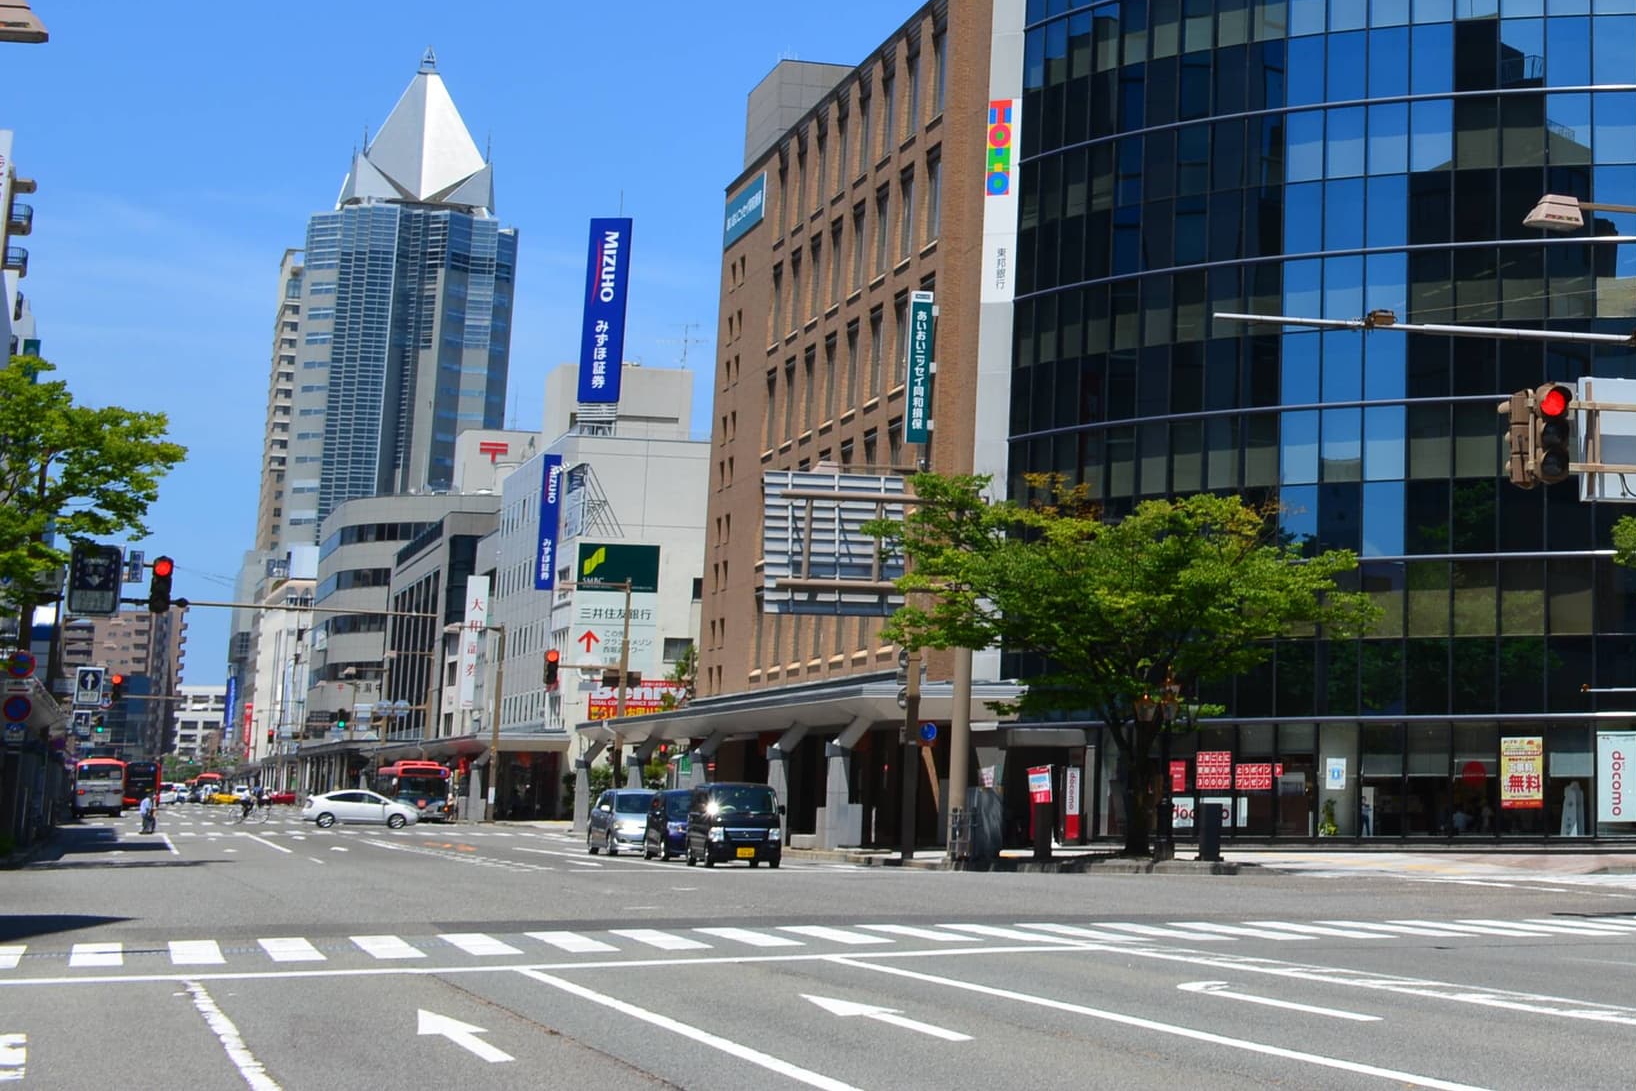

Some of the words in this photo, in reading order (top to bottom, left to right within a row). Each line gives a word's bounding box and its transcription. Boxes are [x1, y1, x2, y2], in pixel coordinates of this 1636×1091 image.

[600, 231, 620, 303] MIZUHO
[996, 248, 1006, 290] 東邦銀行
[591, 320, 608, 389] みずほ証券
[1069, 771, 1077, 810] docomo
[1509, 774, 1541, 793] 無料
[1611, 750, 1624, 816] docomo
